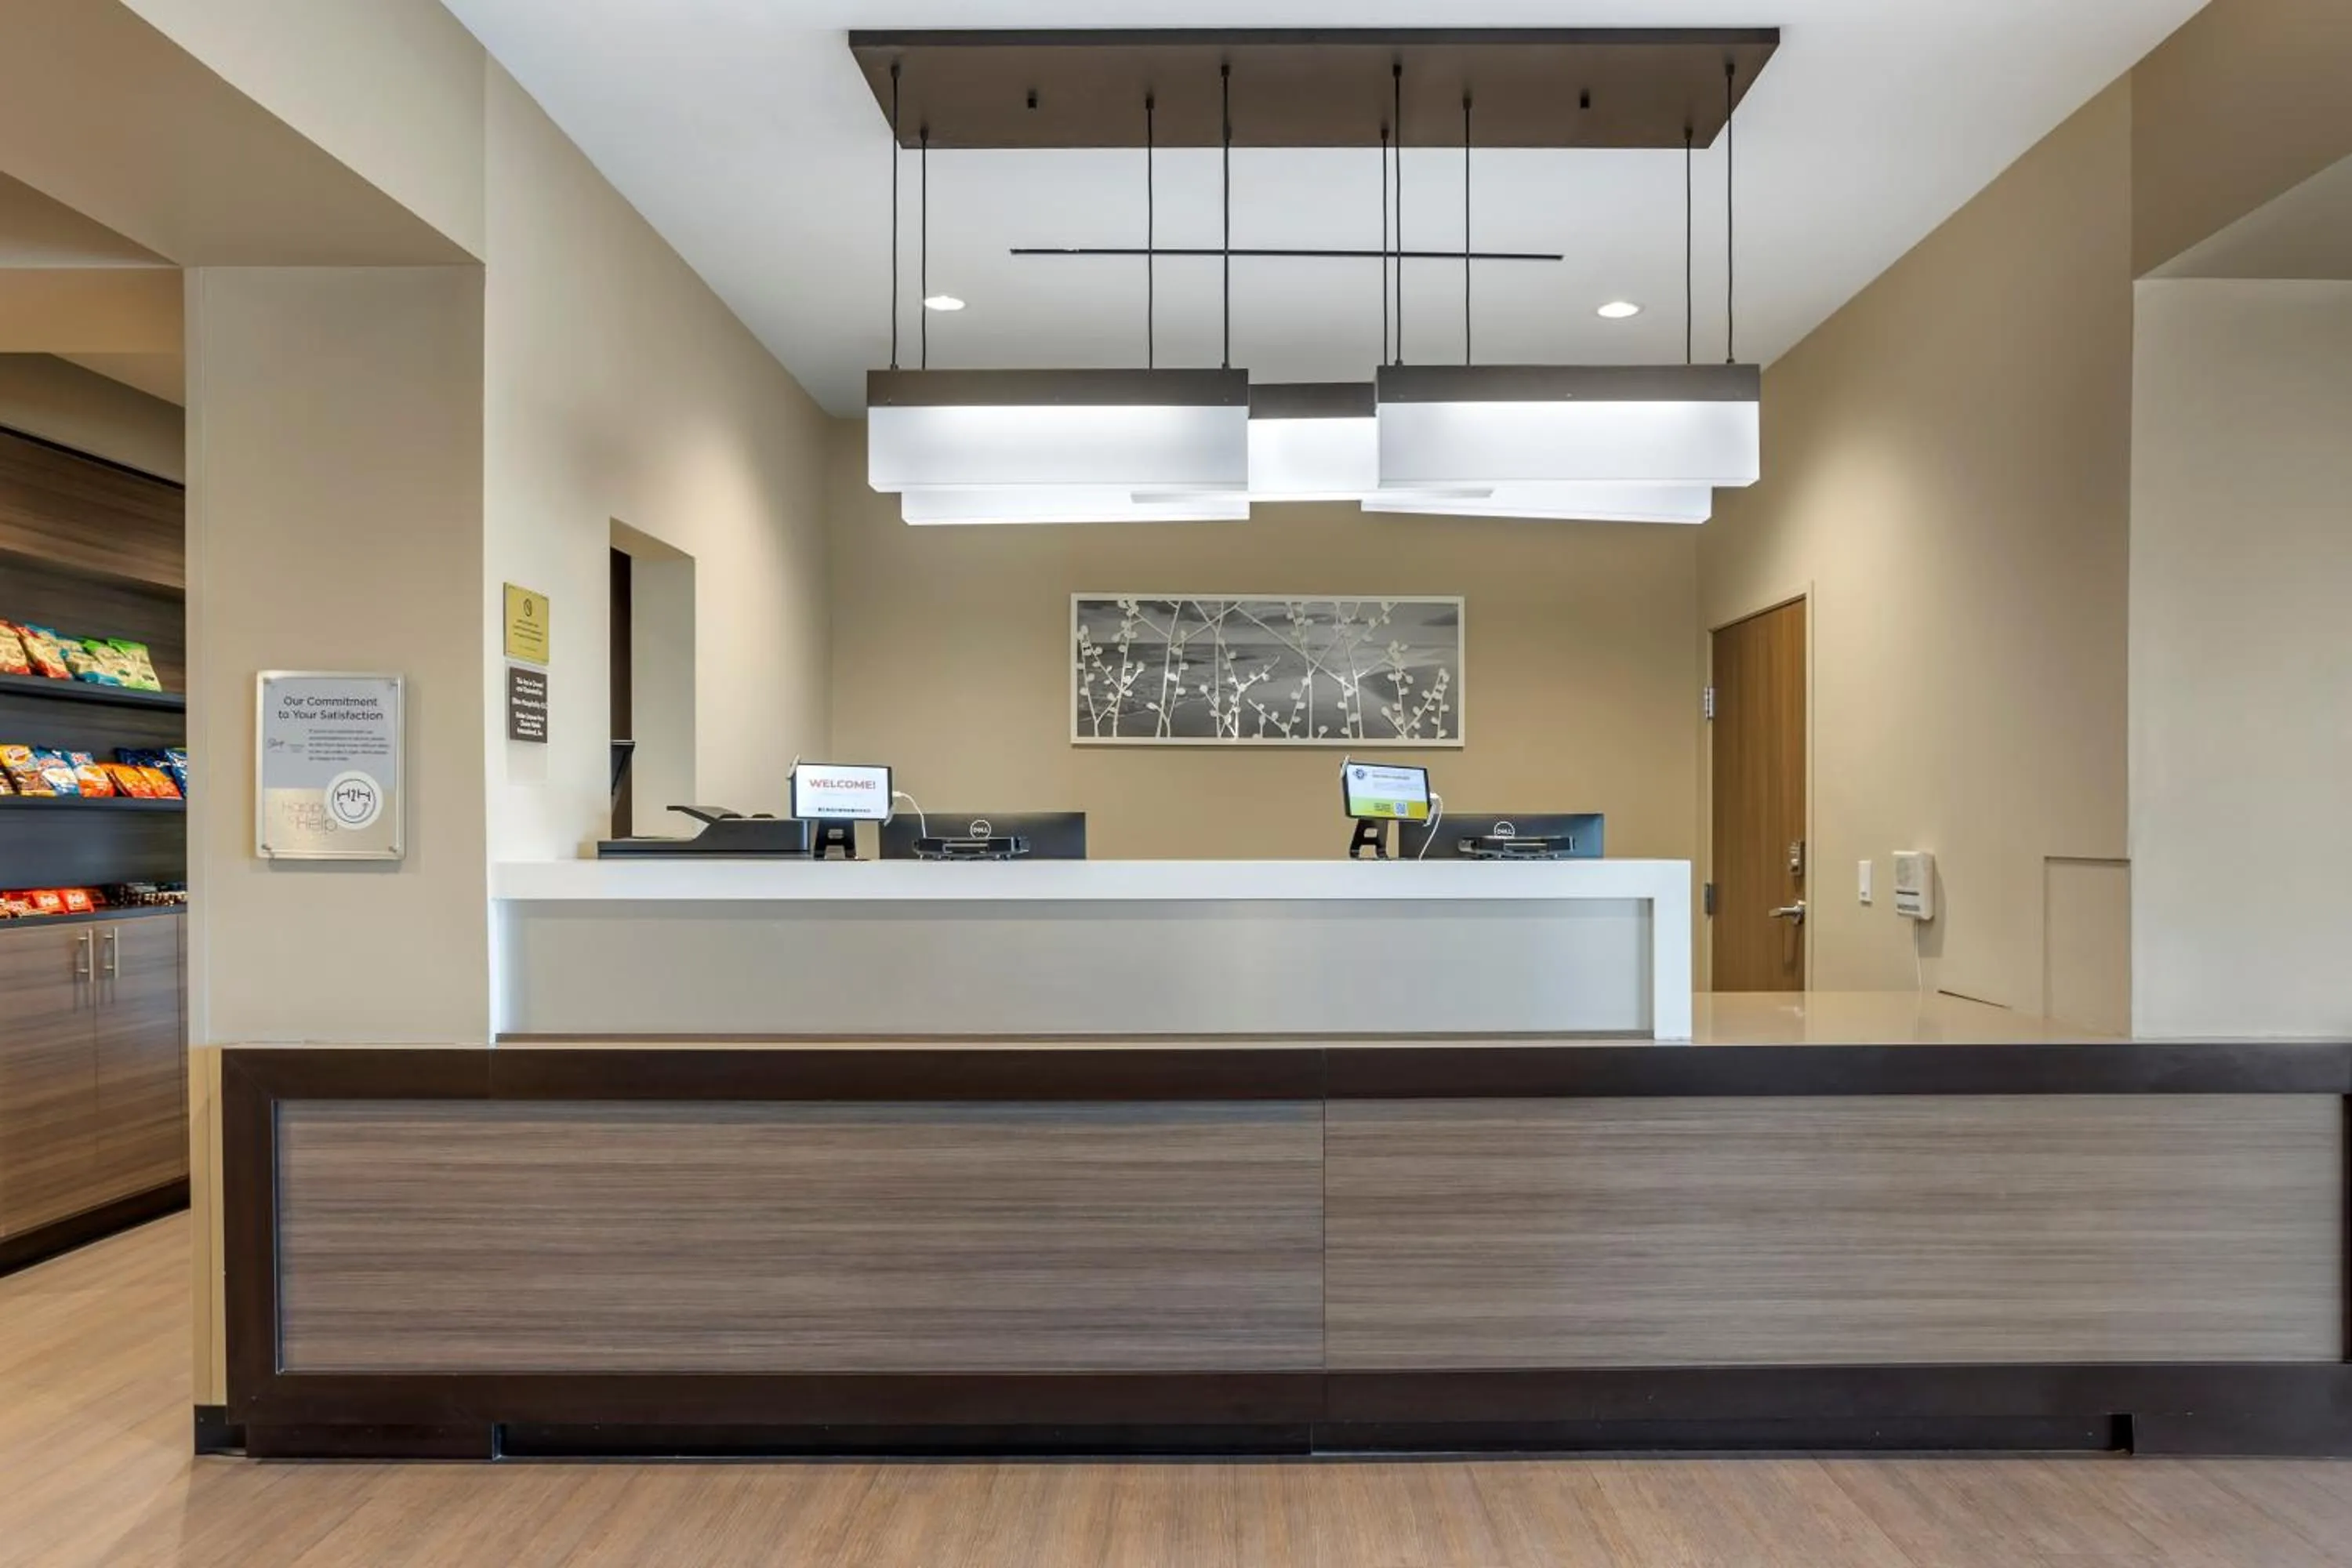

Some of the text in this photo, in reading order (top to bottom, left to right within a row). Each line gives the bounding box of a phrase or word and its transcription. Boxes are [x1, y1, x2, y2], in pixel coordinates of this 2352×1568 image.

[283, 696, 378, 706] Our Commitment
[278, 710, 384, 720] to Your Satisfaction
[809, 779, 877, 789] WELCOME!
[296, 814, 338, 835] Help
